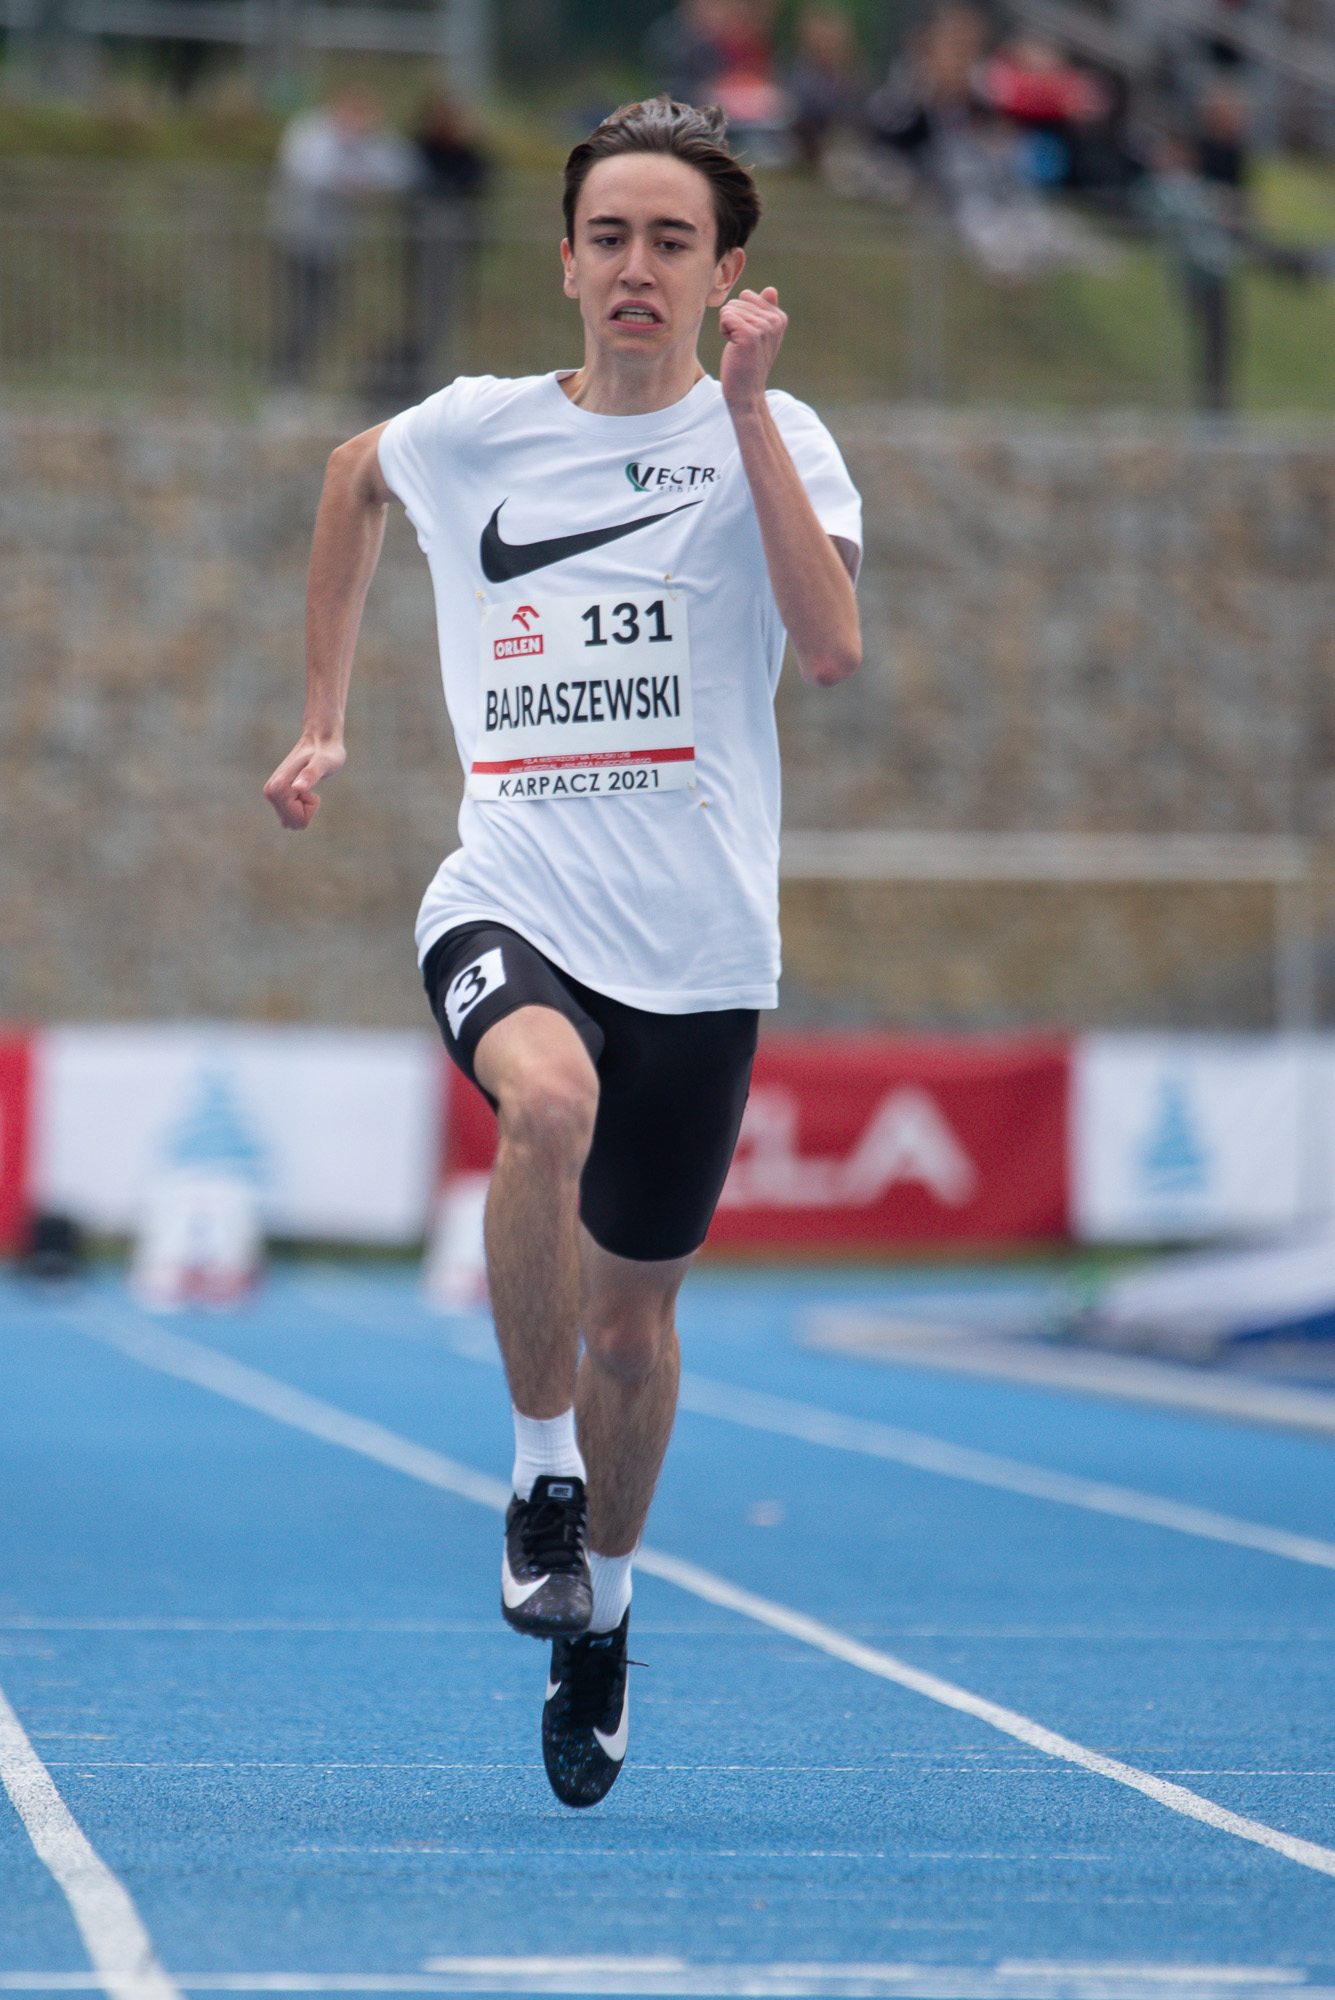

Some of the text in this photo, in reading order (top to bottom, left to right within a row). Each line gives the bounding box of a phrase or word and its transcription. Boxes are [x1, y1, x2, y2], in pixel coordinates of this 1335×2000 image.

[630, 463, 720, 487] VECTR
[581, 600, 672, 647] 131
[495, 637, 541, 658] ORLEN
[485, 675, 680, 732] BAJRASZEWSKI
[498, 769, 659, 797] KARPACZ 2021
[453, 965, 487, 1014] 3
